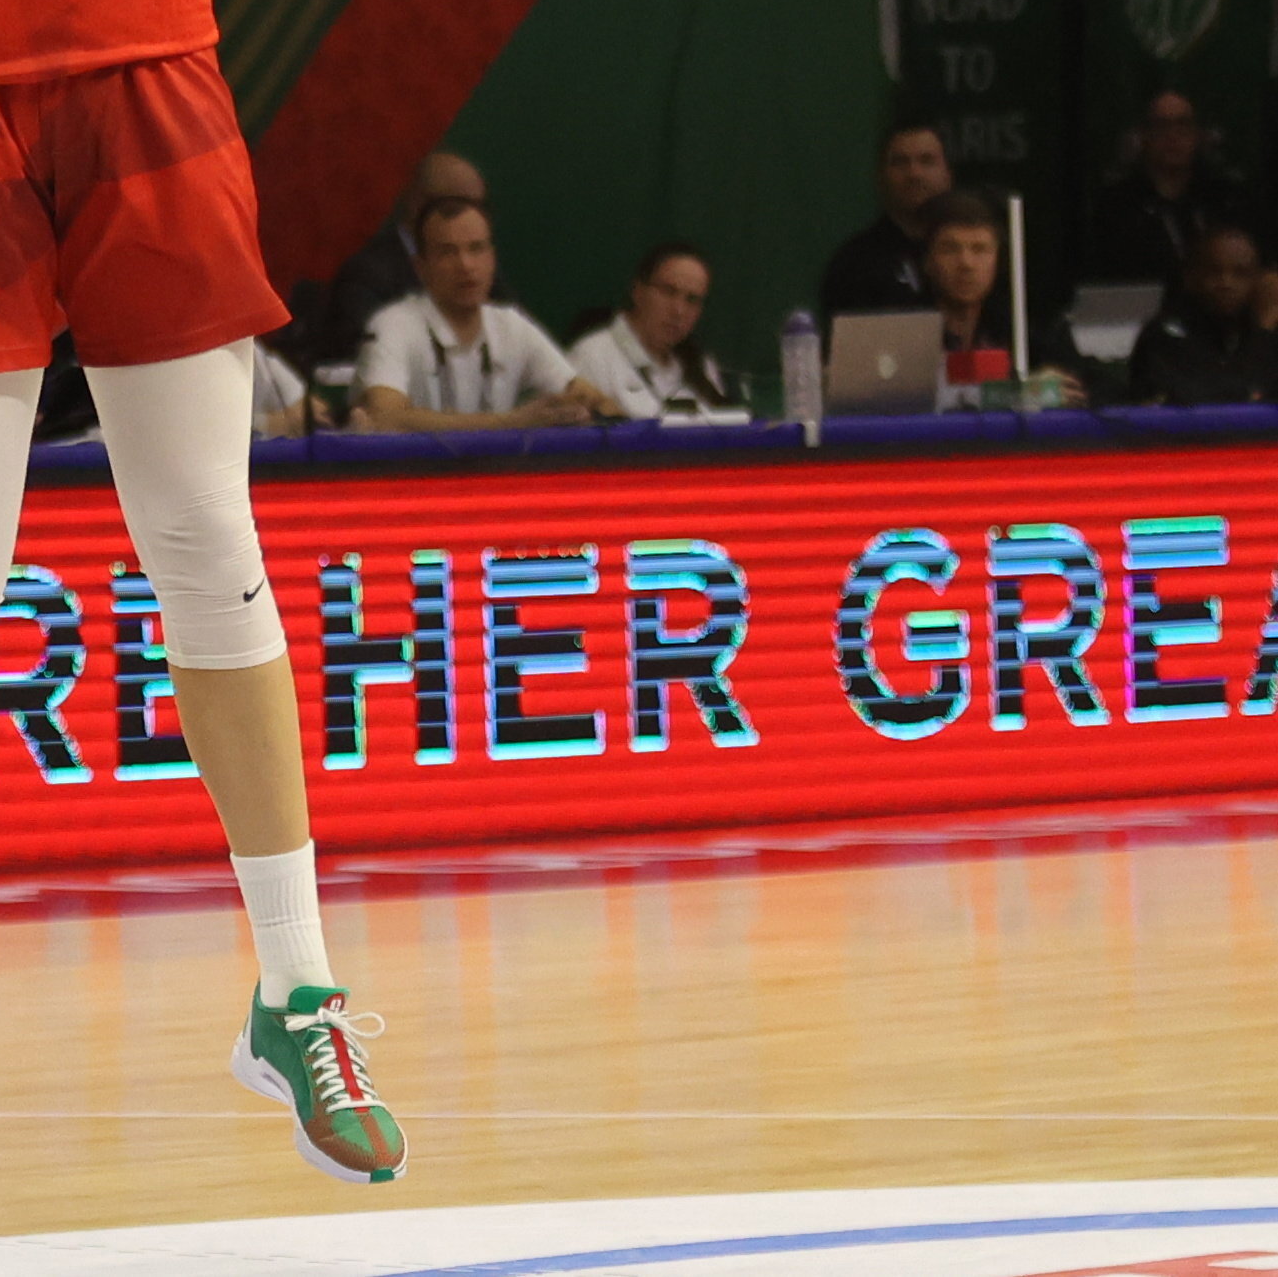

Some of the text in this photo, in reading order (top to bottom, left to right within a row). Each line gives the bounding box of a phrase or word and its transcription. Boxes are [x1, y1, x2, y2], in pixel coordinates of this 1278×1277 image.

[939, 45, 995, 93] TO
[316, 537, 761, 771] HER
[831, 515, 1278, 741] GRE
